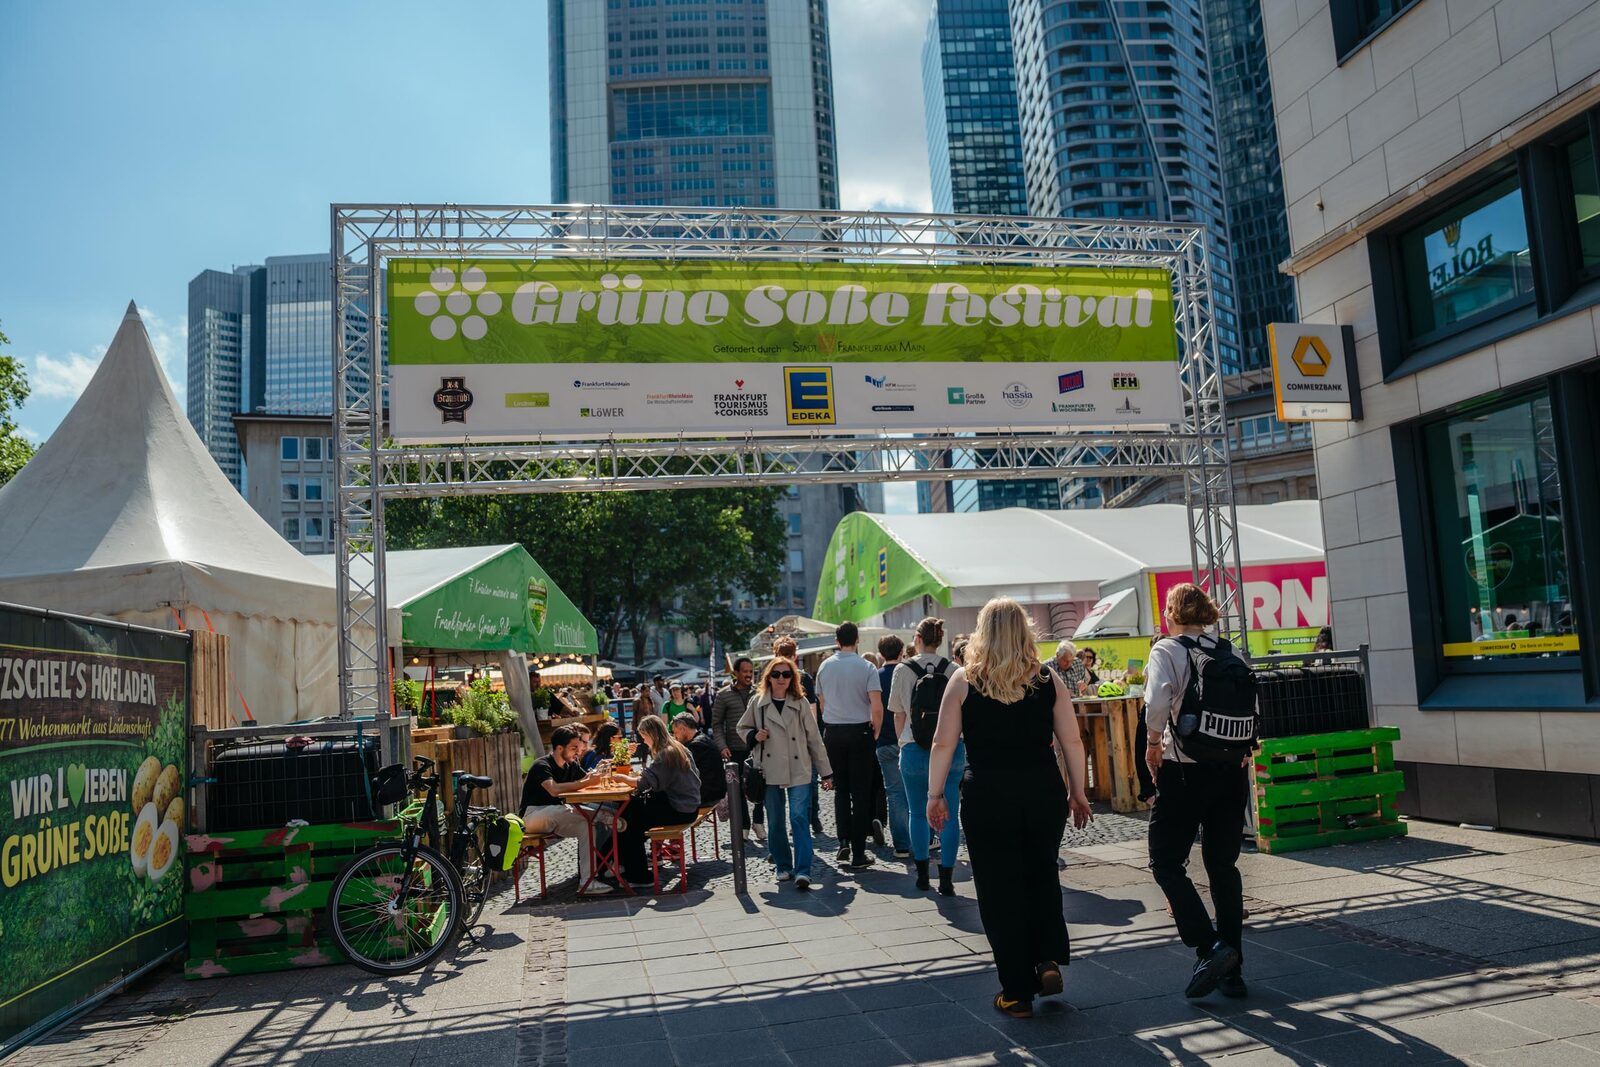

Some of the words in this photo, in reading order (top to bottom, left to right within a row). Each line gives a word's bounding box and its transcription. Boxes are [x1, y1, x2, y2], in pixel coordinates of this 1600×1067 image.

[511, 273, 729, 326] Grüne
[744, 284, 909, 328] Soße
[758, 345, 782, 353] durch
[1003, 391, 1032, 399] hassia
[1113, 377, 1137, 387] FFH
[1287, 383, 1342, 391] COMMERZBANK
[714, 401, 768, 409] TOURISMUS
[791, 412, 831, 420] EDEKA
[434, 608, 476, 639] Frankfurter
[0, 658, 87, 700] ZSCHEL'S
[92, 664, 157, 706] HOFLADEN
[18, 714, 91, 741] Wochenmarkt
[92, 722, 107, 734] aus
[108, 716, 152, 740] Leidenschaft
[1203, 713, 1254, 739] PUMA
[10, 773, 54, 820] WIR
[1, 816, 81, 889] GRÜNE
